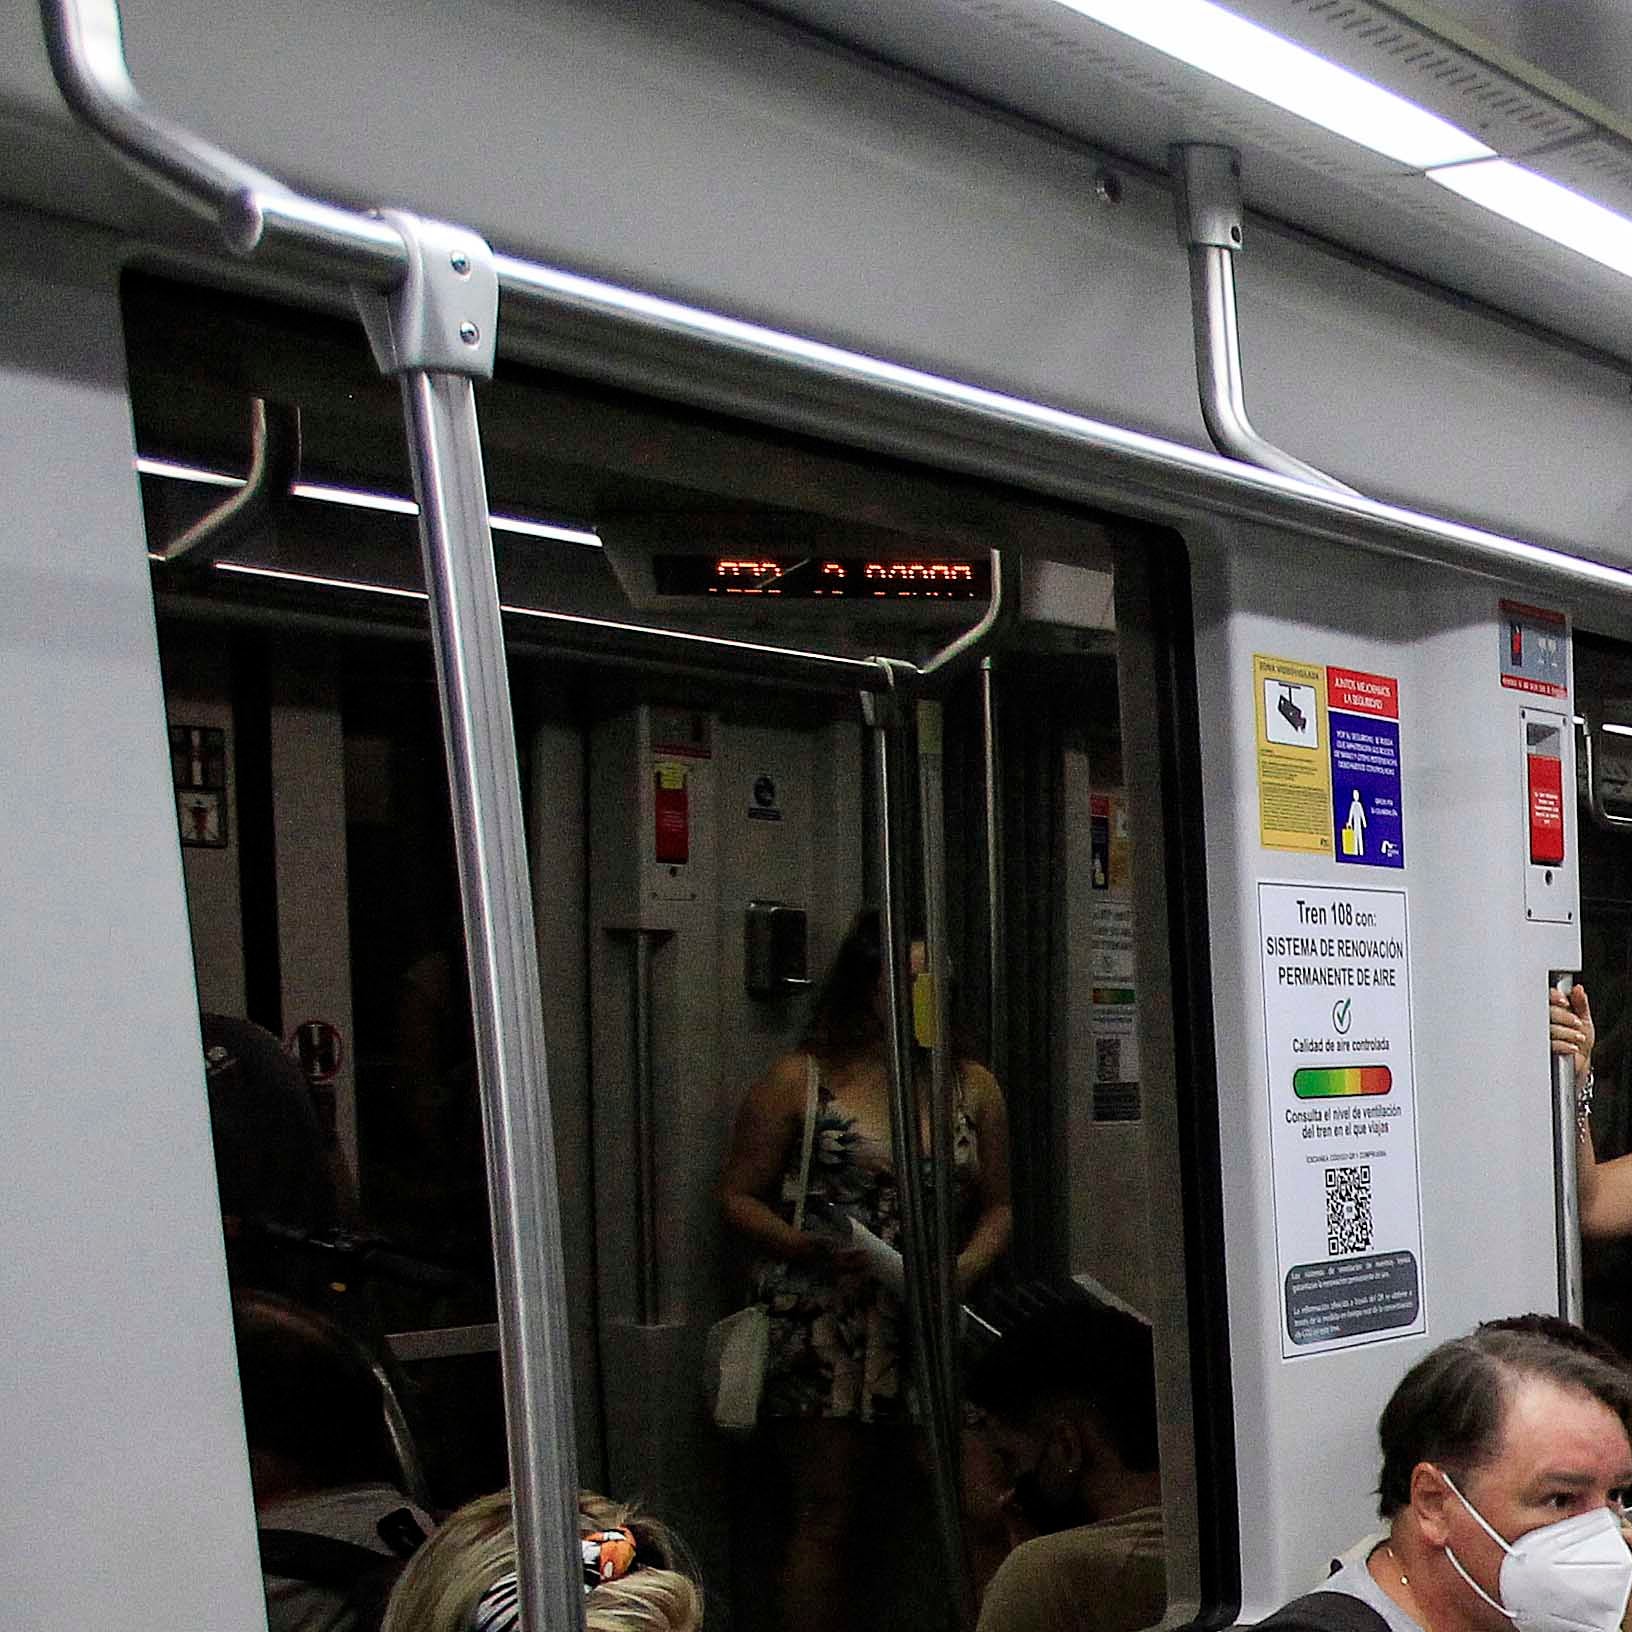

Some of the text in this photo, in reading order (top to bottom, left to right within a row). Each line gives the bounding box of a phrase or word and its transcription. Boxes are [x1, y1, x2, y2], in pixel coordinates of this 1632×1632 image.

[1296, 900, 1377, 927] Tren 108 con:
[1266, 936, 1403, 959] SISTEMA DE RENOVACIÓN
[1278, 966, 1396, 986] PERMANENTE DE AIRE
[1293, 1037, 1390, 1053] Calidad de aire controlada
[1286, 1104, 1402, 1124] Consulta el nivel de ventilación
[1302, 1121, 1389, 1139] del tren en el que viajas
